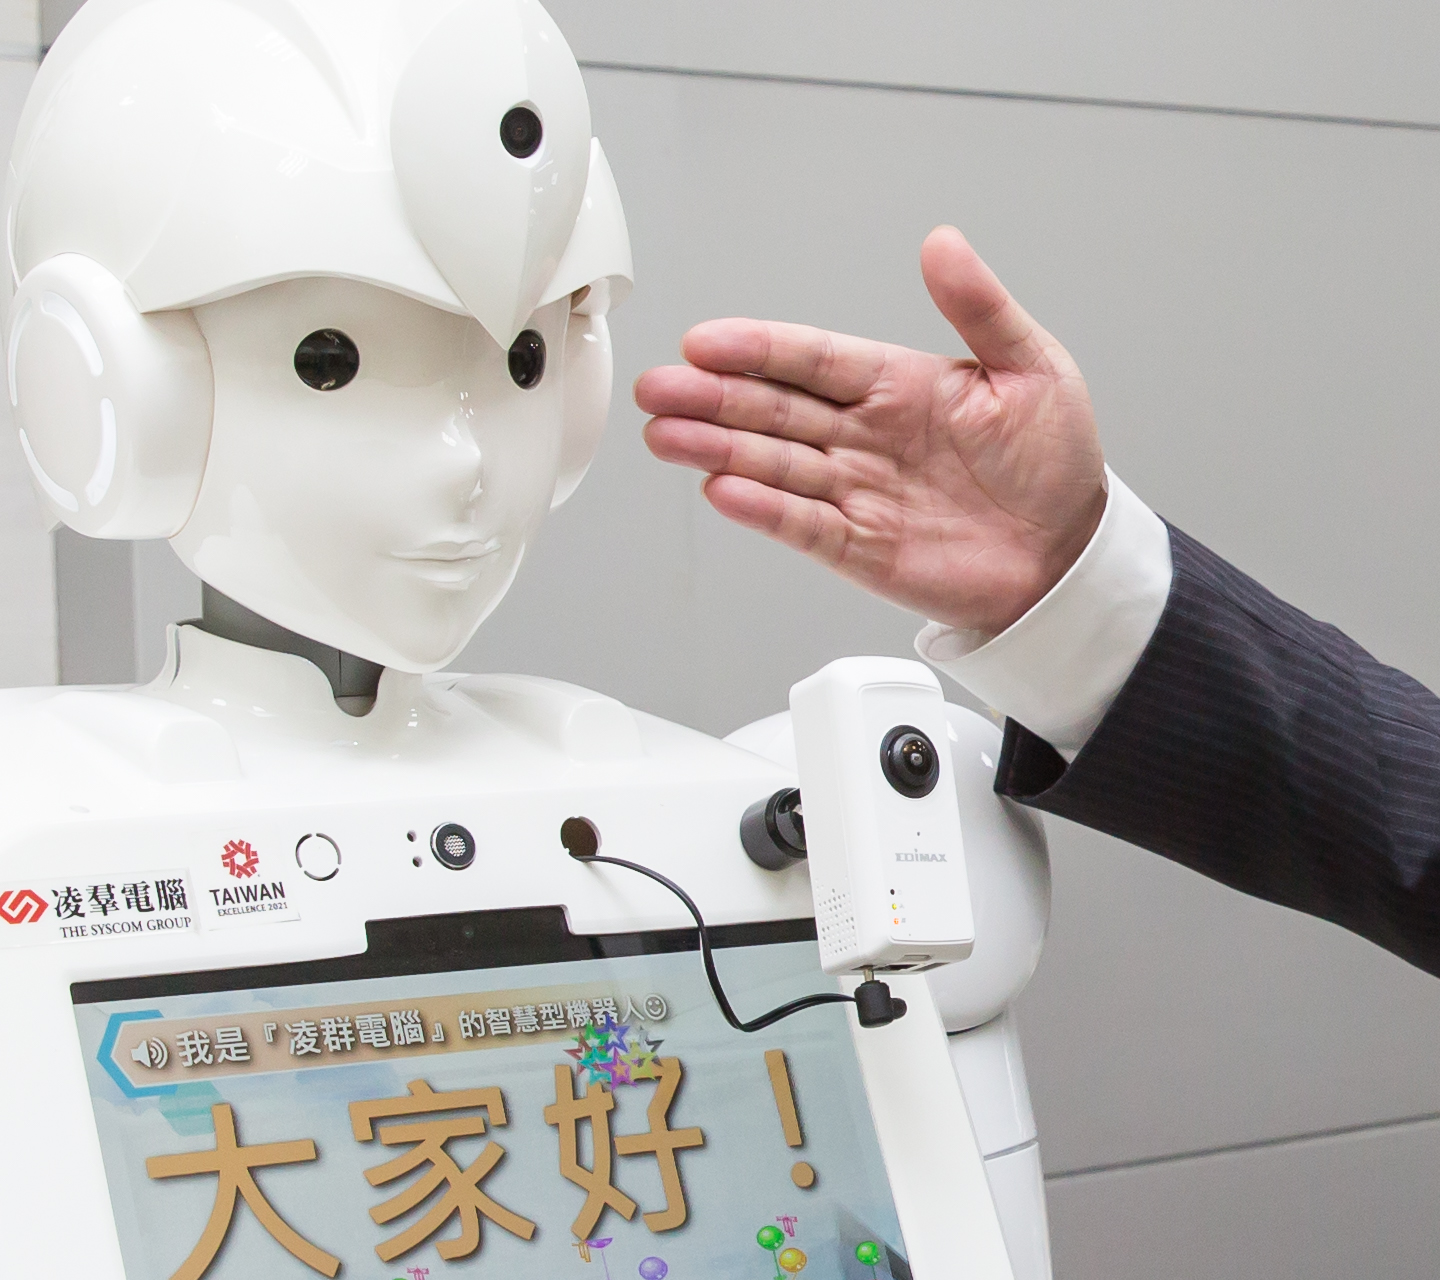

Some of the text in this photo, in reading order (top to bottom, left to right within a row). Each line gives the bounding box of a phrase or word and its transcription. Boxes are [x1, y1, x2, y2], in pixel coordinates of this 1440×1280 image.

[209, 882, 285, 906] TAIWAN
[217, 901, 288, 917] EXCELLENCE 2021
[60, 917, 192, 938] THE SYSCOM GROUP
